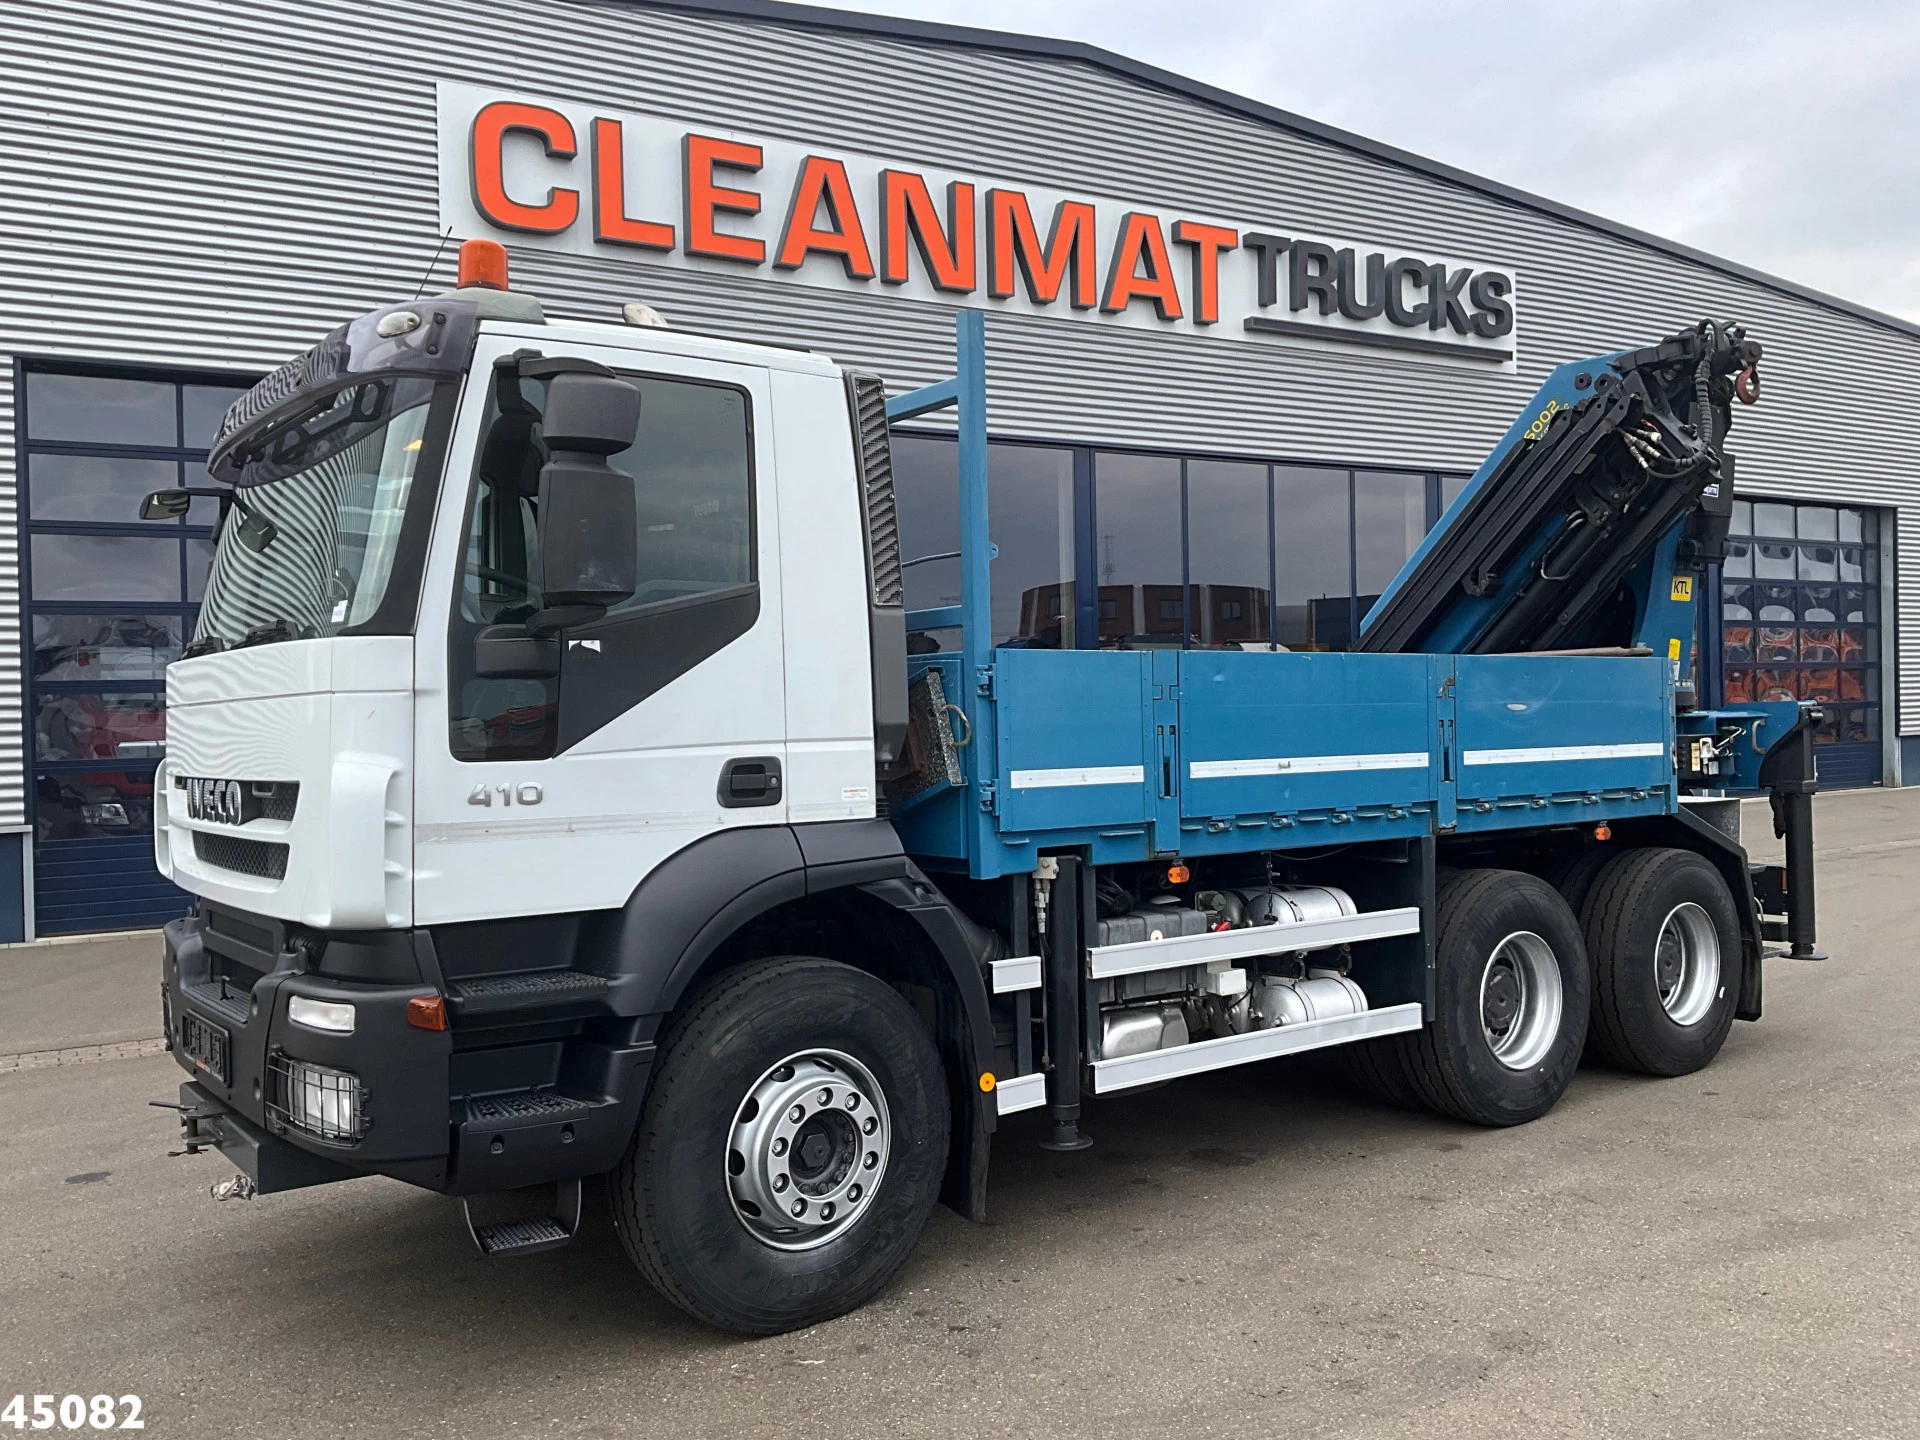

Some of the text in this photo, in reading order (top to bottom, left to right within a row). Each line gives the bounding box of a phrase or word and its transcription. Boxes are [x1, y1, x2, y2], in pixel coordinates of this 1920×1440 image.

[469, 101, 1513, 338] CLEANMAT TRUCKS
[1673, 580, 1689, 594] KTL
[186, 778, 241, 826] IVECO
[467, 781, 543, 807] 410
